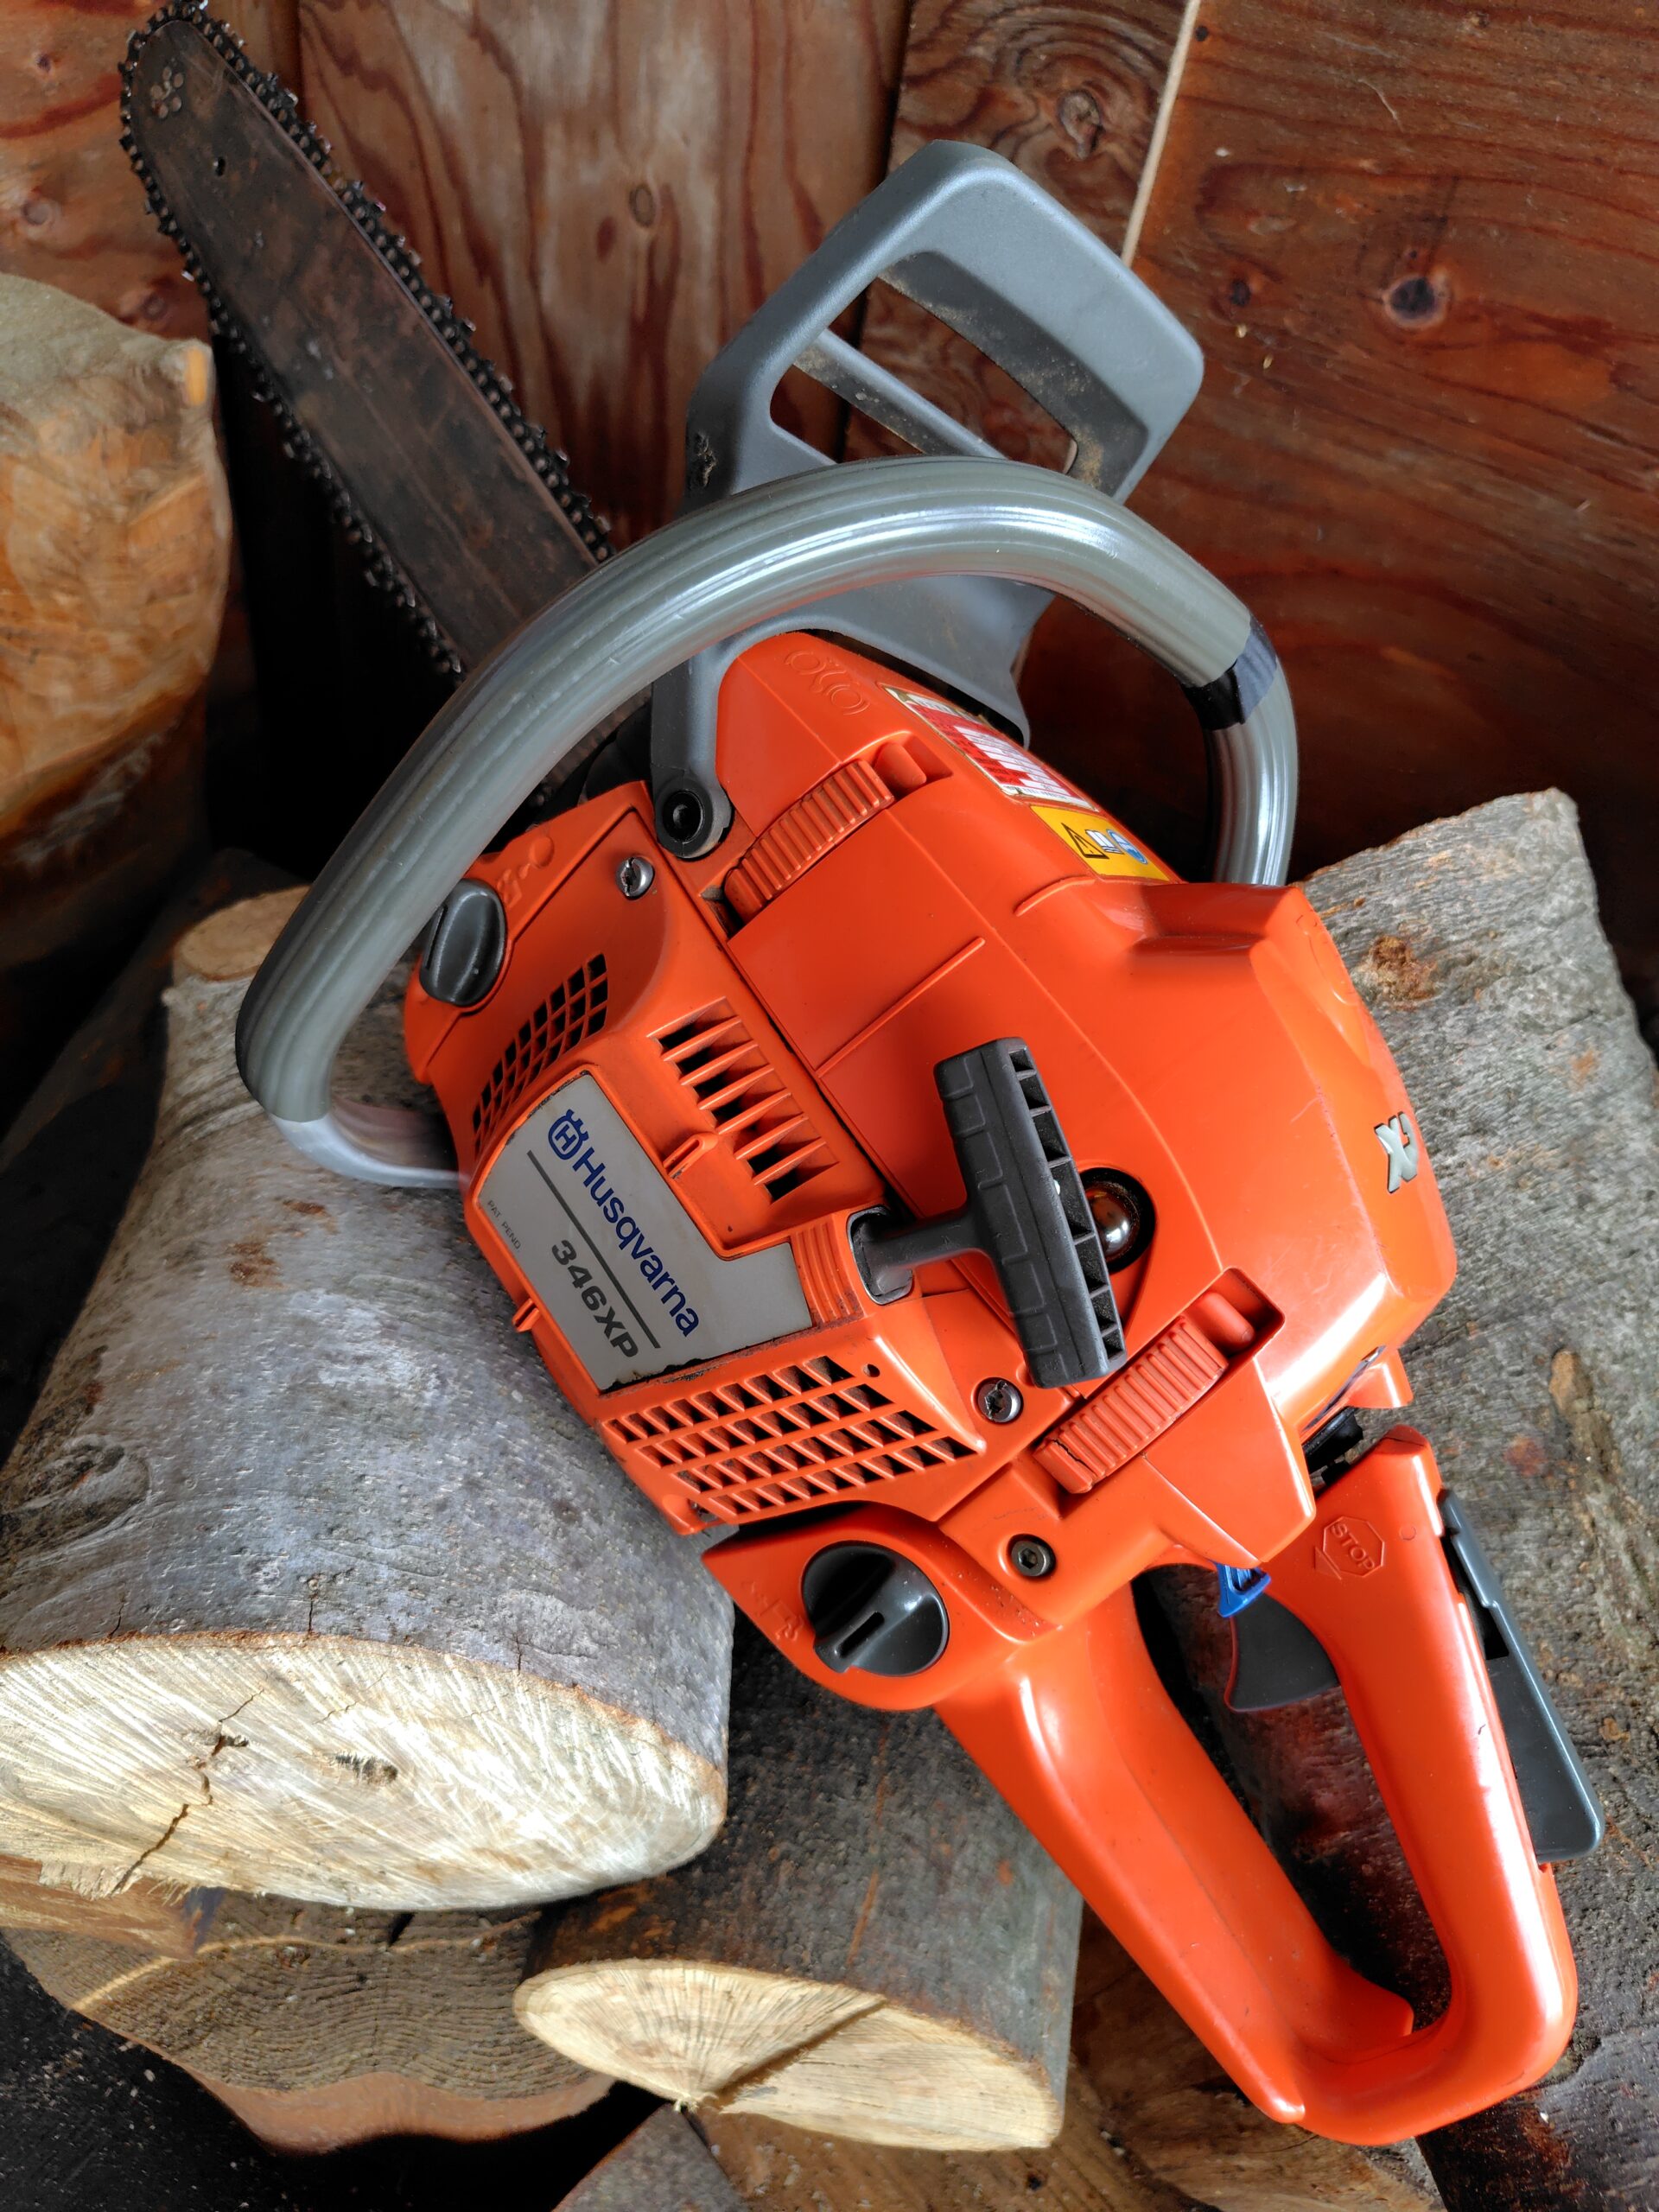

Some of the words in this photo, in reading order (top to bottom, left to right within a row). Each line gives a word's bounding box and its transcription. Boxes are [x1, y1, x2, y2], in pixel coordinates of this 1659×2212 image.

[551, 1239, 639, 1357] 346XP
[572, 1147, 699, 1337] Husqvarna
[1331, 1522, 1376, 1570] STOP
